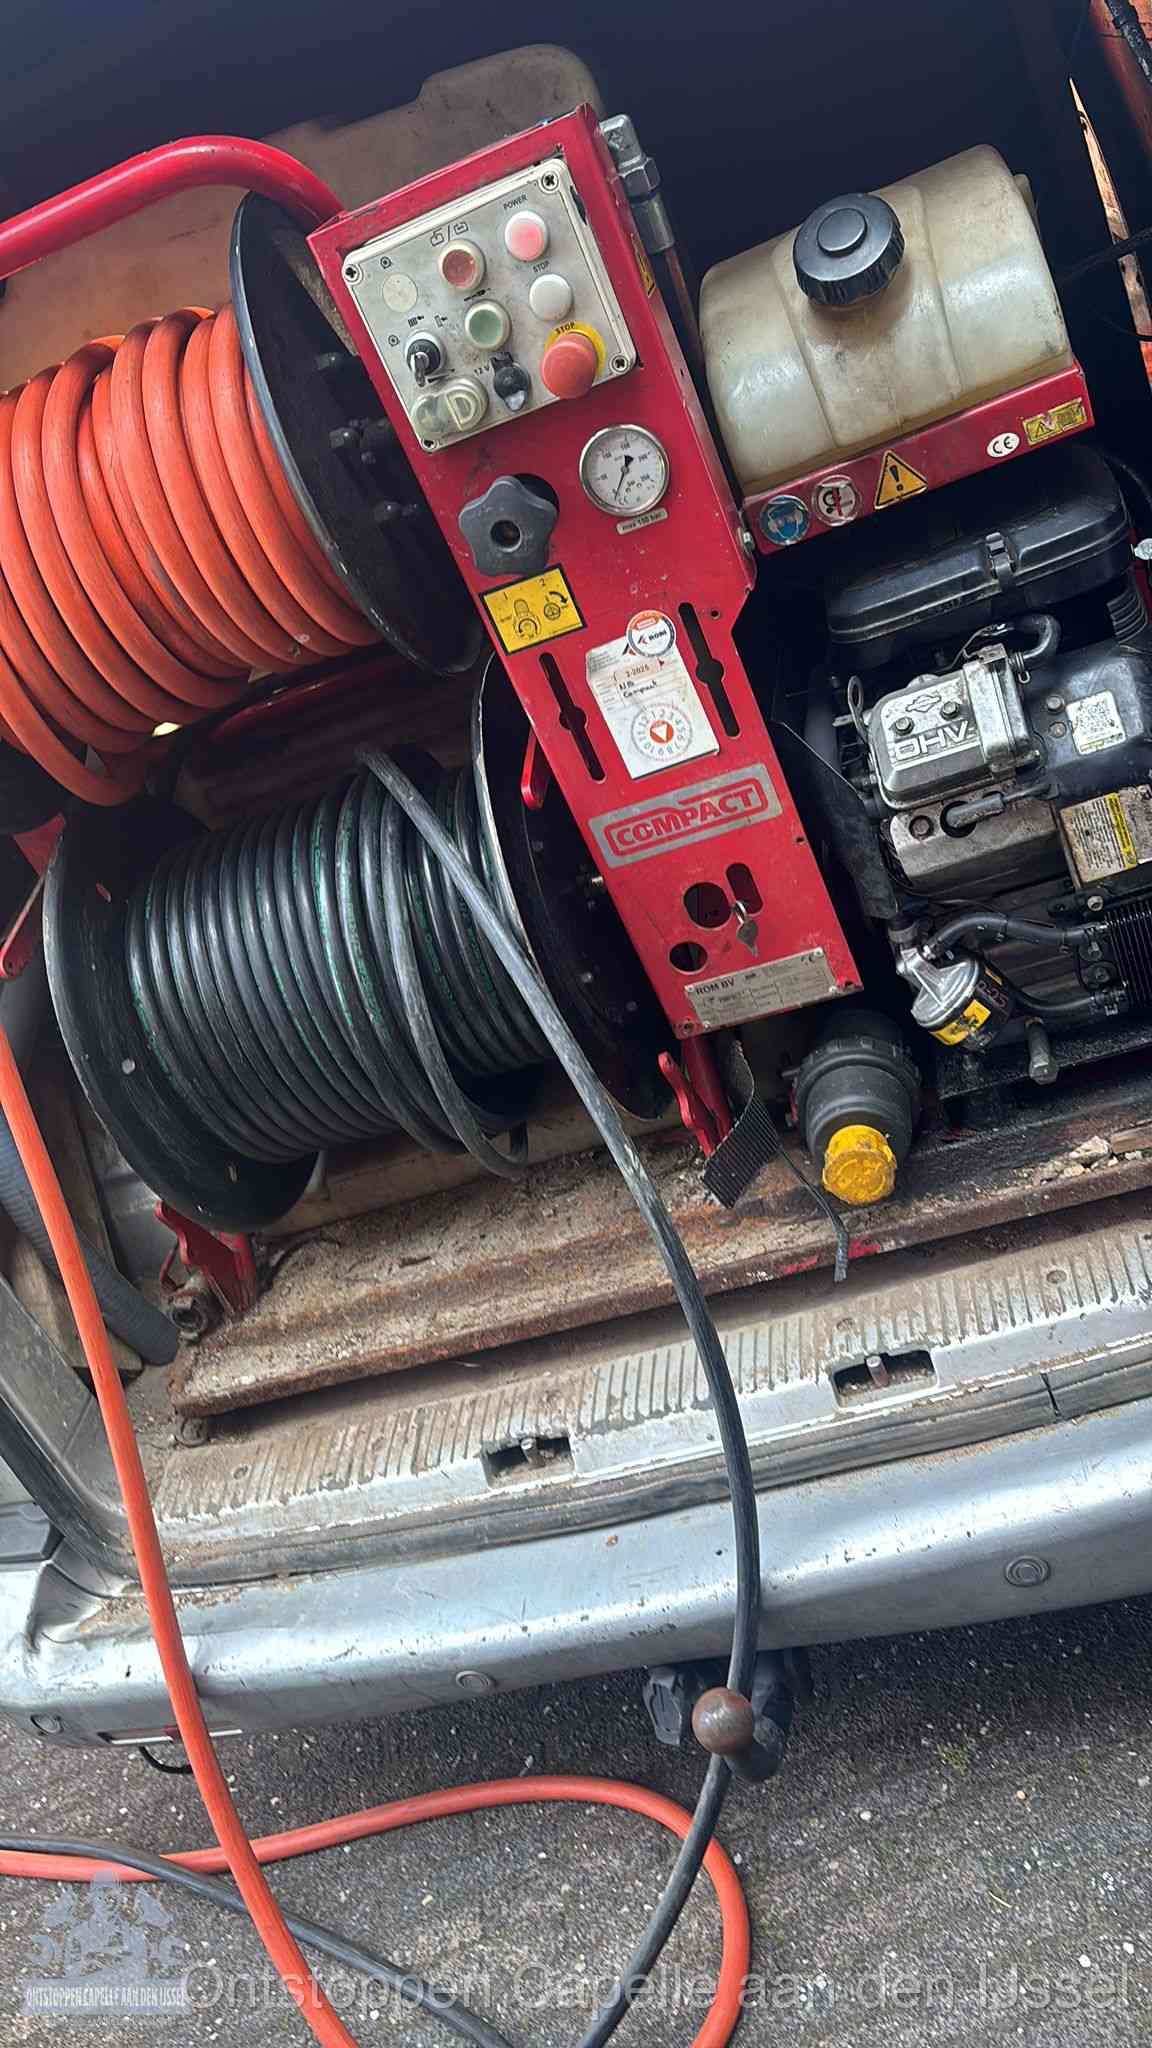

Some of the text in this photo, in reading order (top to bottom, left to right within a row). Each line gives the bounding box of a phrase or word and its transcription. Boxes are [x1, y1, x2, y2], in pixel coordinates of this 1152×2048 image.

[503, 194, 528, 211] POWER
[532, 260, 551, 274] STOP
[555, 321, 577, 336] STOP
[894, 719, 970, 762] OHV
[616, 787, 757, 847] COMPACT
